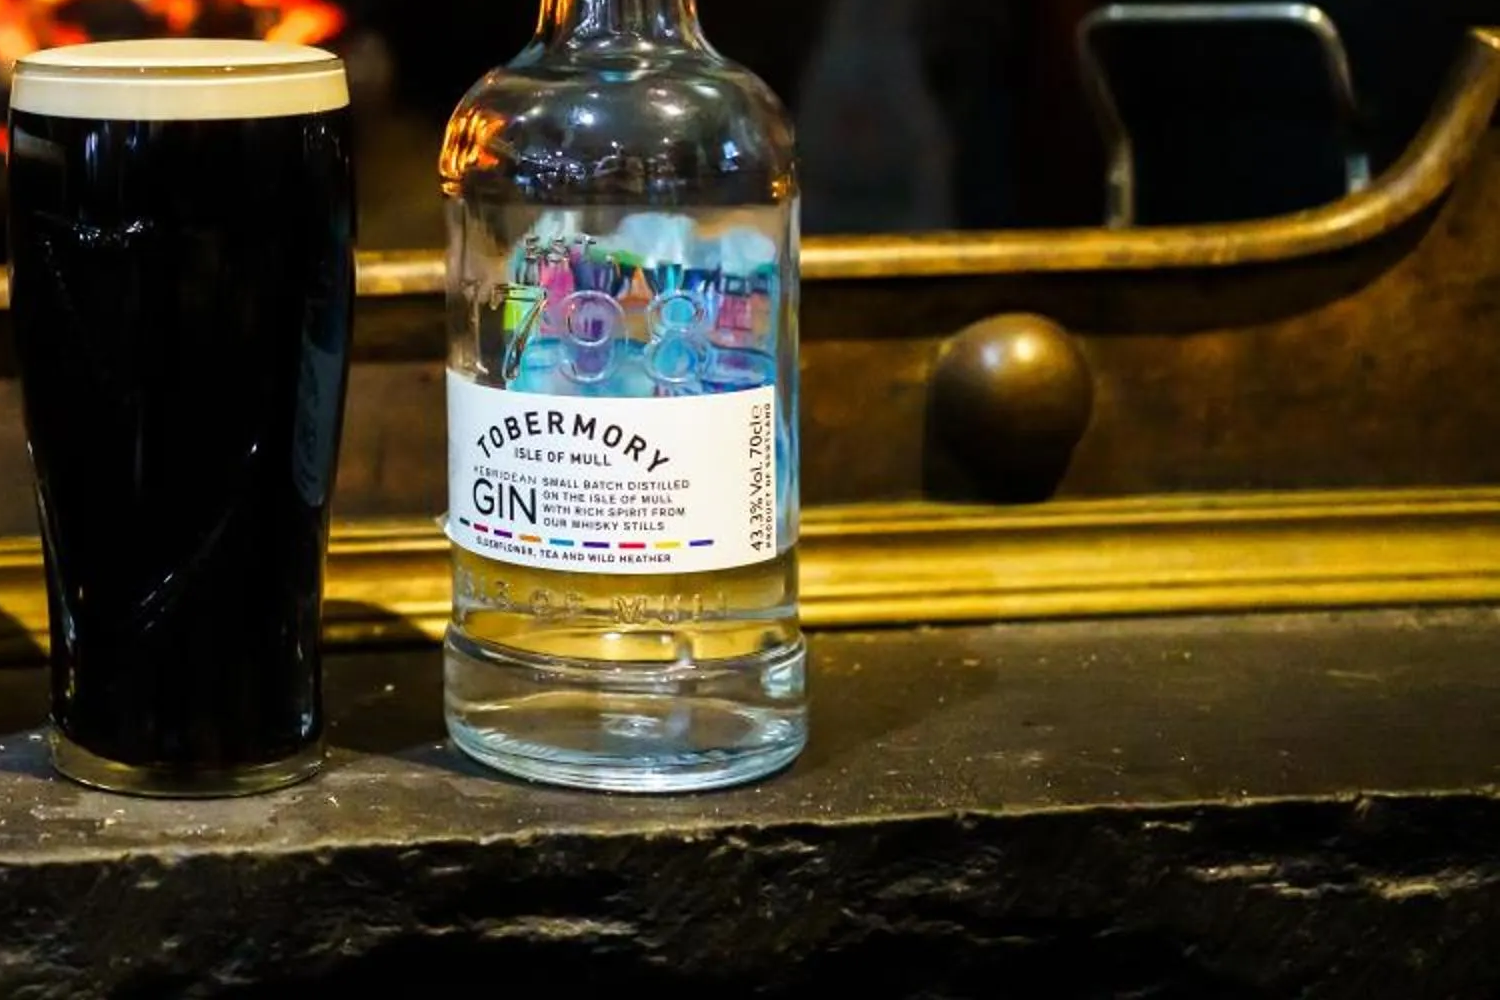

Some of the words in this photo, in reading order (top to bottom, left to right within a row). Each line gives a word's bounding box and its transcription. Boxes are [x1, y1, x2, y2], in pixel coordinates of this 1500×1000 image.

[477, 410, 670, 472] TOBERMORY
[514, 448, 542, 461] ISLE
[547, 452, 564, 463] OF
[570, 453, 612, 466] MULL
[542, 477, 579, 489] SMALL
[583, 479, 623, 490] BATCH
[627, 479, 690, 491] DISTILLED
[750, 462, 763, 497] Vol.
[473, 477, 537, 524] GIN
[542, 490, 559, 501] ON
[563, 492, 585, 503] THE
[589, 494, 616, 504] ISLE
[620, 494, 637, 504] OF
[641, 495, 673, 504] MULL
[542, 503, 570, 514] WITH
[575, 505, 604, 516] RICH
[607, 507, 648, 517] SPIRIT
[651, 507, 685, 517] FROM
[543, 517, 567, 528] OUR
[571, 519, 619, 530] WHISKY
[623, 521, 665, 531] STILLS
[540, 550, 561, 559] TEA
[562, 552, 585, 561] AND
[588, 553, 615, 563] WILD
[619, 553, 671, 563] HEATHER
